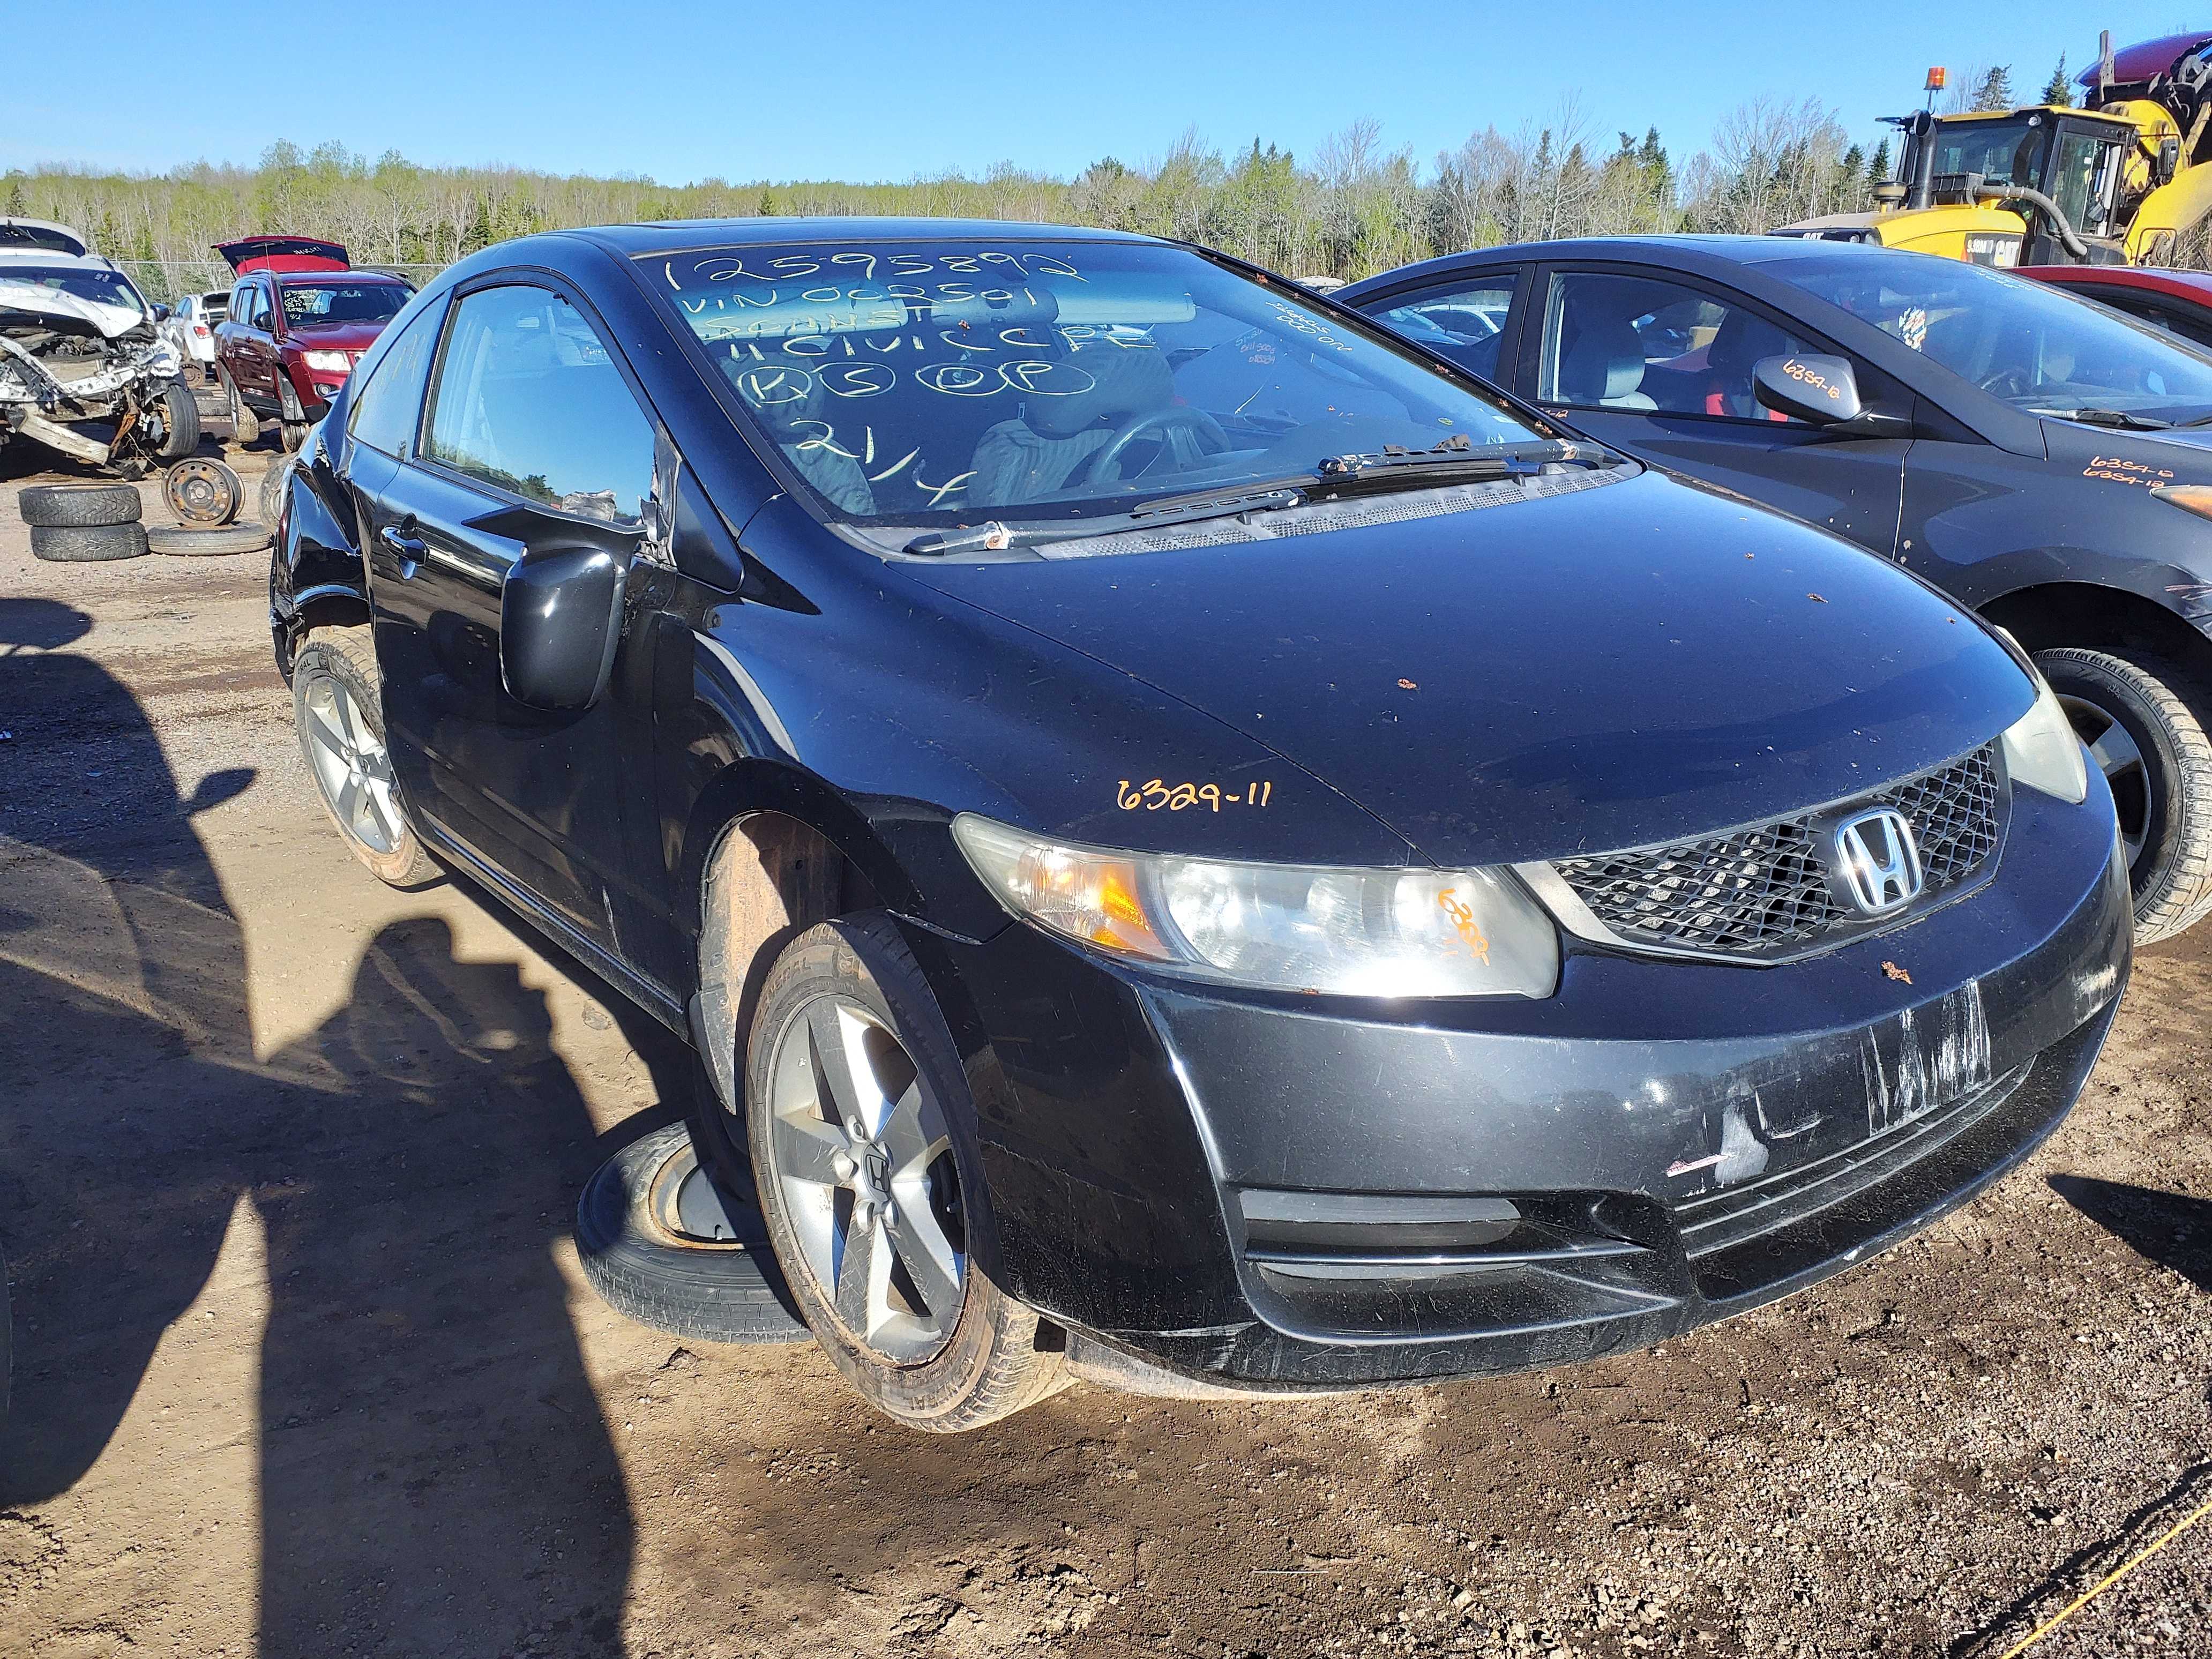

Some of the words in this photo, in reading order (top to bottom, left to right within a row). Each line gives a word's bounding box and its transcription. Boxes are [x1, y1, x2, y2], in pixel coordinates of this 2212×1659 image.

[1994, 240, 2020, 267] CAT
[665, 252, 1090, 290] 12595892
[682, 289, 778, 313] VIN
[1117, 779, 1271, 812] 6329-11
